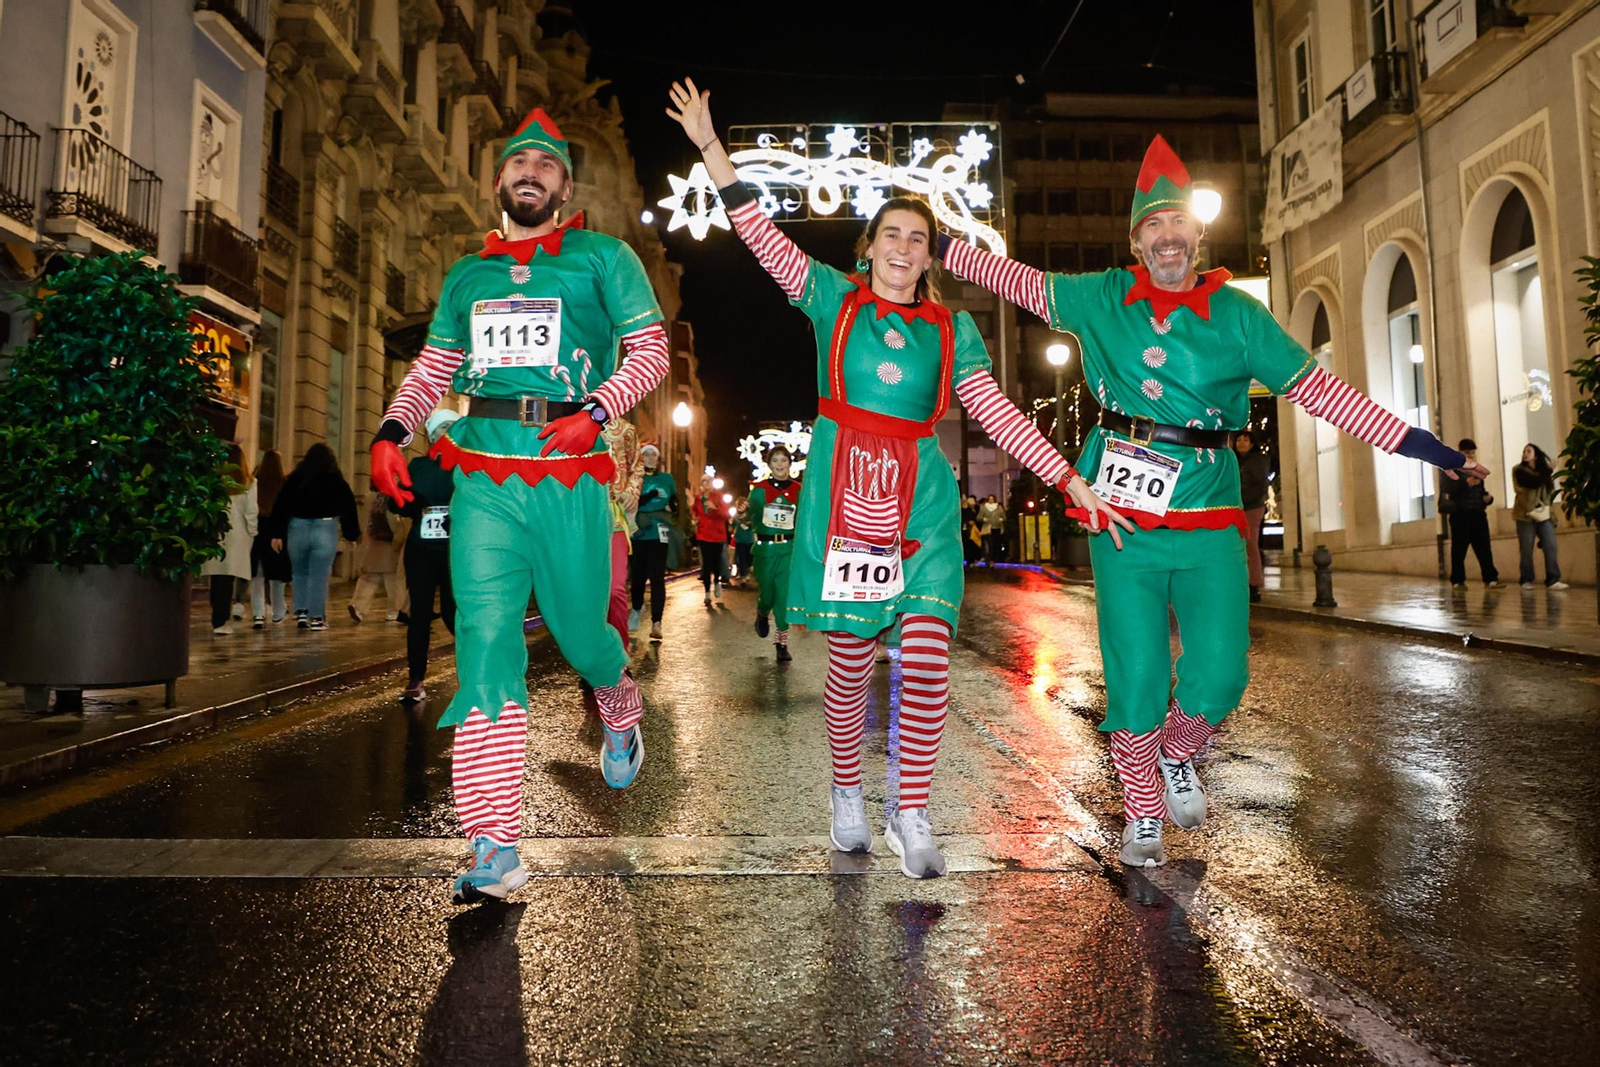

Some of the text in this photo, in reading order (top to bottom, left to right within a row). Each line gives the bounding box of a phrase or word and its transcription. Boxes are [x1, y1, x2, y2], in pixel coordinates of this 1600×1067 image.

[483, 324, 551, 347] 1113
[1105, 463, 1165, 498] 1210
[774, 513, 786, 522] 15
